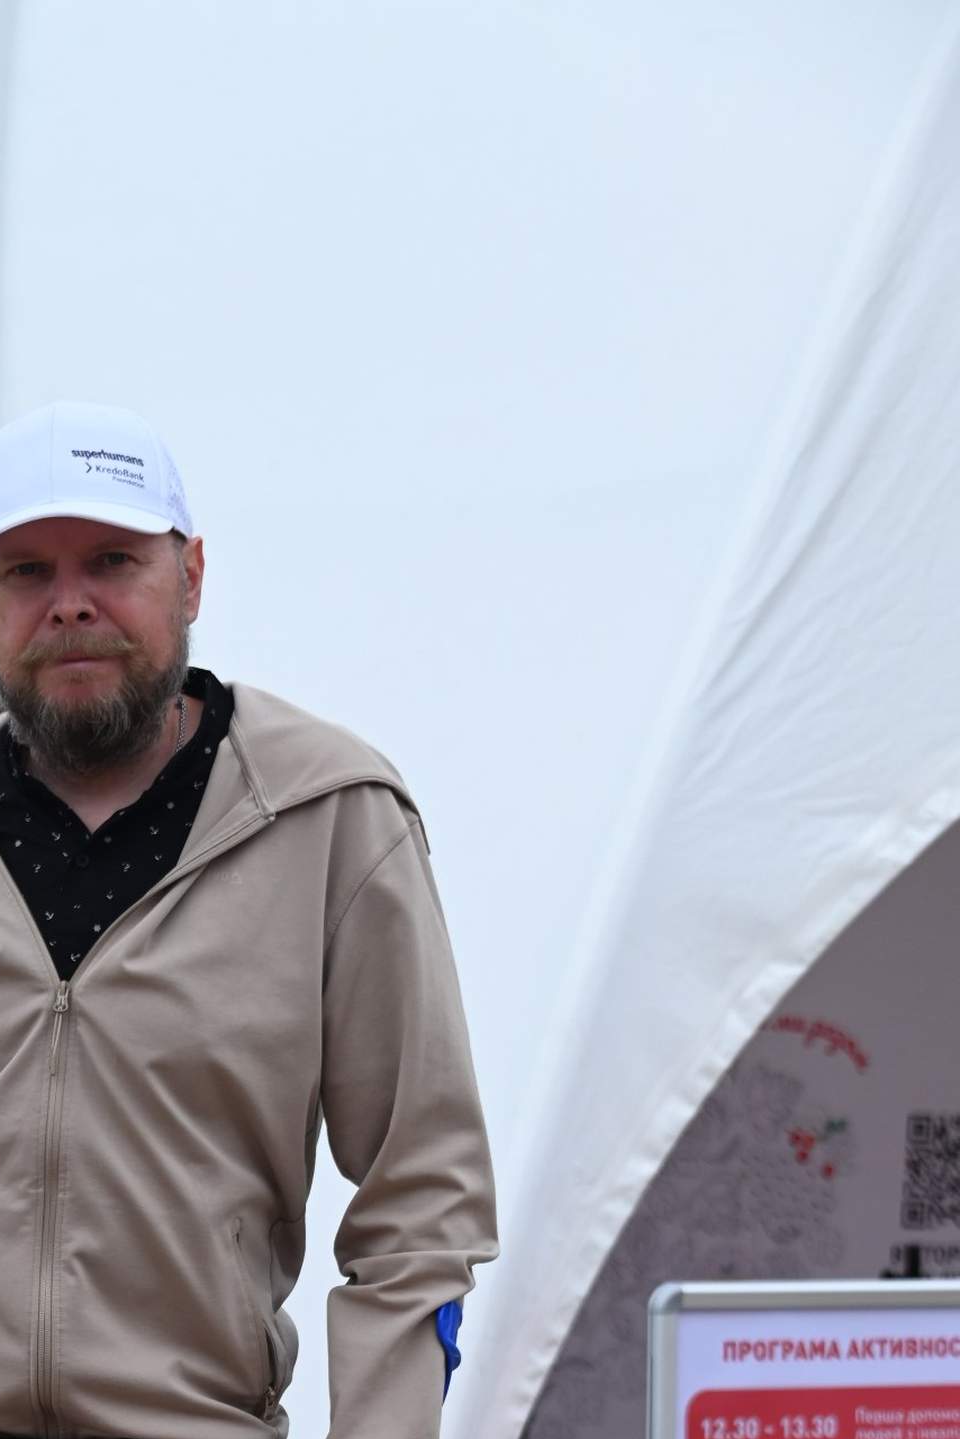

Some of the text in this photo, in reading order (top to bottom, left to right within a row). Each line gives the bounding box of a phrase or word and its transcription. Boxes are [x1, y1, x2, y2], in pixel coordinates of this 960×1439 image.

[71, 449, 144, 467] superhumans
[95, 465, 144, 482] KredoBank
[722, 1338, 840, 1362] ПРОГРАМА
[780, 1415, 838, 1438] 13.30
